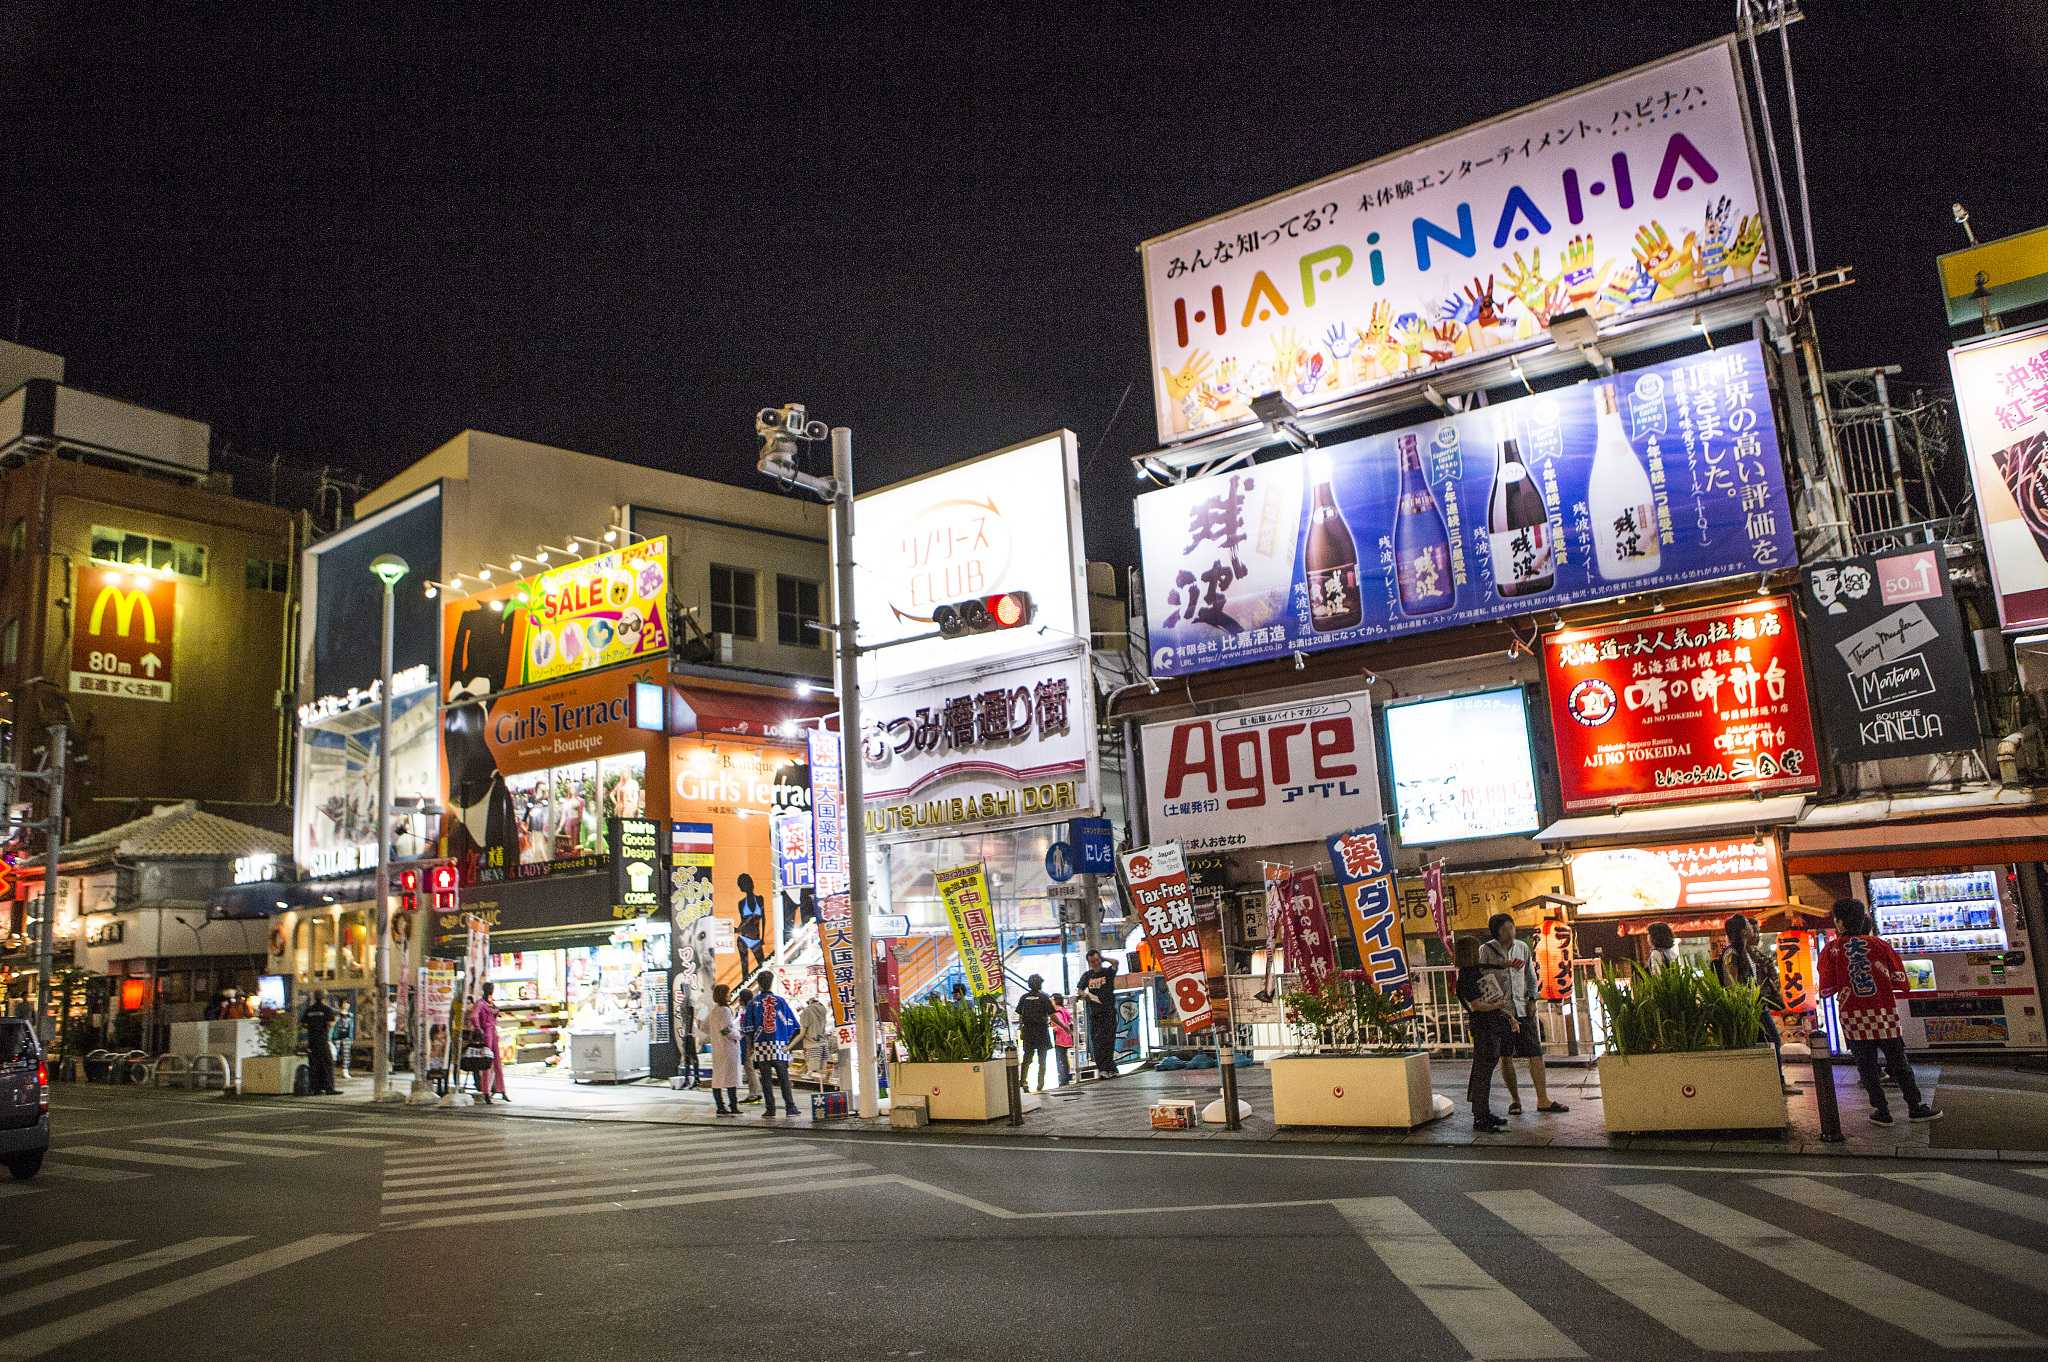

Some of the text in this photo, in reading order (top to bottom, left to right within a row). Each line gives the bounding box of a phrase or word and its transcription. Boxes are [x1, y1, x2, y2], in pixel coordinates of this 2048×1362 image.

[1167, 202, 1338, 279] みんな知ってる?
[1687, 360, 1736, 497] 頂きました。
[1436, 461, 1458, 471] AWARD
[1721, 352, 1778, 565] 世界の高い評価を
[1573, 501, 1594, 585] 残波ホワイト
[1613, 506, 1645, 560] 残波
[1163, 474, 1255, 633] 残波
[1473, 526, 1493, 602] 残波ブラック
[1511, 527, 1540, 580] 残波
[911, 560, 985, 607] CLUB
[1414, 546, 1443, 600] 残波
[1885, 576, 1923, 593] 50m
[544, 577, 604, 619] SALE
[1294, 582, 1312, 636] 残波古酒
[643, 622, 663, 649] 2F
[1176, 625, 1286, 657] 有限会社 比嘉酒造
[1288, 626, 1388, 650] お酒は20歳になってから。
[1559, 612, 1782, 668] 北海道で大人気の拉麺店
[89, 651, 132, 675] 80m
[1180, 659, 1195, 667] URL
[1632, 646, 1752, 678] 北海道札幌拉麺
[1624, 657, 1787, 714] 味の時計台
[1862, 666, 1921, 704] Montana
[495, 706, 548, 744] Girl's
[861, 677, 1069, 762] むつみ橋通り街
[1642, 710, 1703, 725] AJI NO TOKEIDAI
[1876, 708, 1921, 721] BOUTIQUE
[554, 734, 603, 754] Boutique
[1583, 743, 1692, 768] AJI NO TOKEIDAI
[1626, 741, 1651, 750] Sapporo
[1651, 738, 1674, 746] Ramen
[557, 767, 588, 785] SALE
[723, 755, 775, 775] Boutique
[1164, 716, 1358, 811] Agre
[676, 769, 741, 802] Girl's
[1281, 781, 1360, 804] アグレ
[864, 780, 1078, 834] MUTSUMIBASHI DORI
[621, 834, 656, 847] Goods
[622, 847, 656, 861] Design
[1085, 843, 1112, 862] にしき
[1190, 833, 1247, 851] 求人おきなわ
[1335, 833, 1383, 878] 薬
[518, 863, 548, 878] LADY's
[588, 857, 597, 867] by
[783, 861, 808, 886] 1F
[624, 893, 657, 904] COSMIC
[1135, 882, 1188, 905] Tax-Free
[1143, 897, 1197, 938] 免税
[715, 939, 735, 949] SALE
[1554, 925, 1573, 996] ラーメン
[1777, 936, 1807, 1010] ラーメン
[1185, 1011, 1212, 1027] DAIKOK
